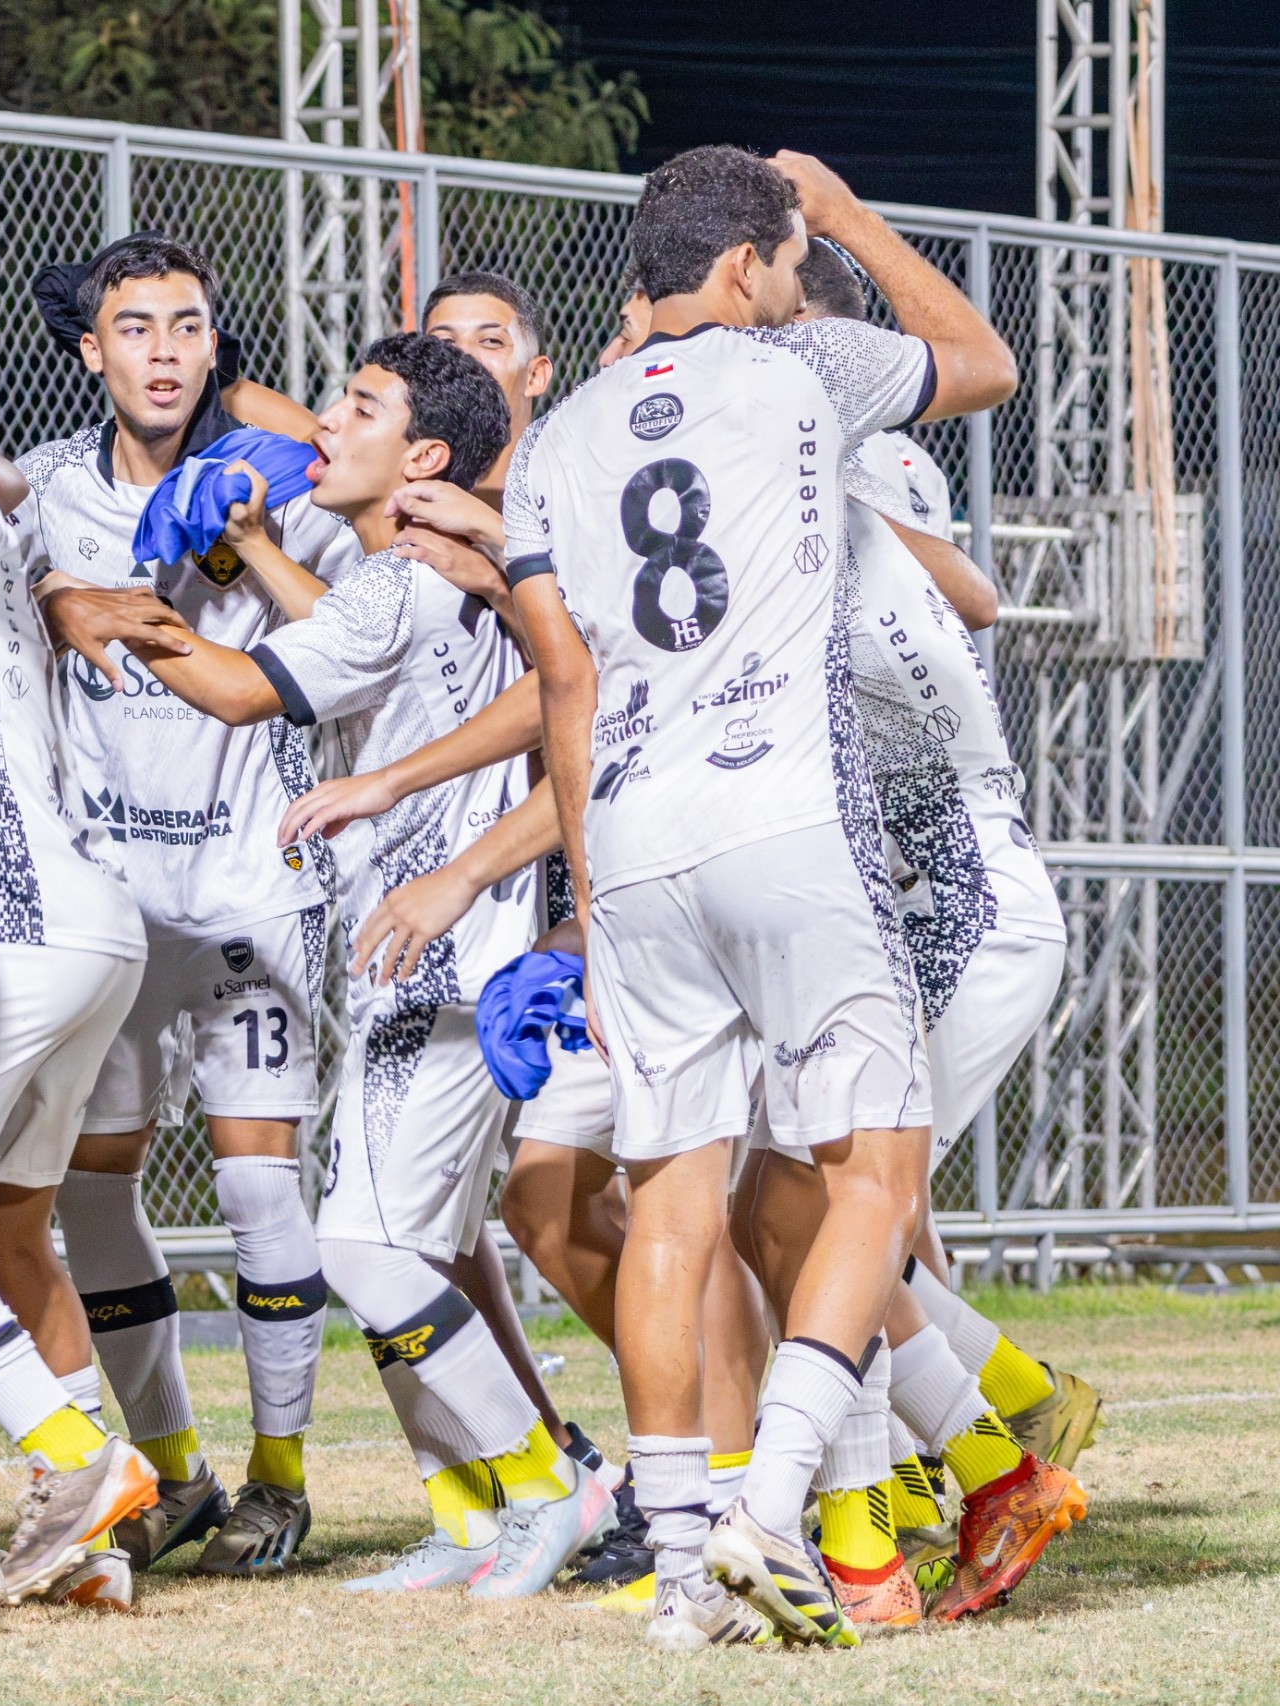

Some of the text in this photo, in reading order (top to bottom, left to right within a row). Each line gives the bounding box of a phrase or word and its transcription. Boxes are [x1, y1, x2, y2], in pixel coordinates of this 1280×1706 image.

[634, 415, 680, 431] MOTOFIVE
[798, 417, 818, 524] serac
[620, 457, 729, 652] 8
[433, 642, 471, 726] erac
[880, 611, 937, 699] serac
[124, 706, 174, 720] PLANOS
[177, 707, 194, 720] DE
[224, 973, 271, 995] Samel
[233, 1006, 288, 1069] 13
